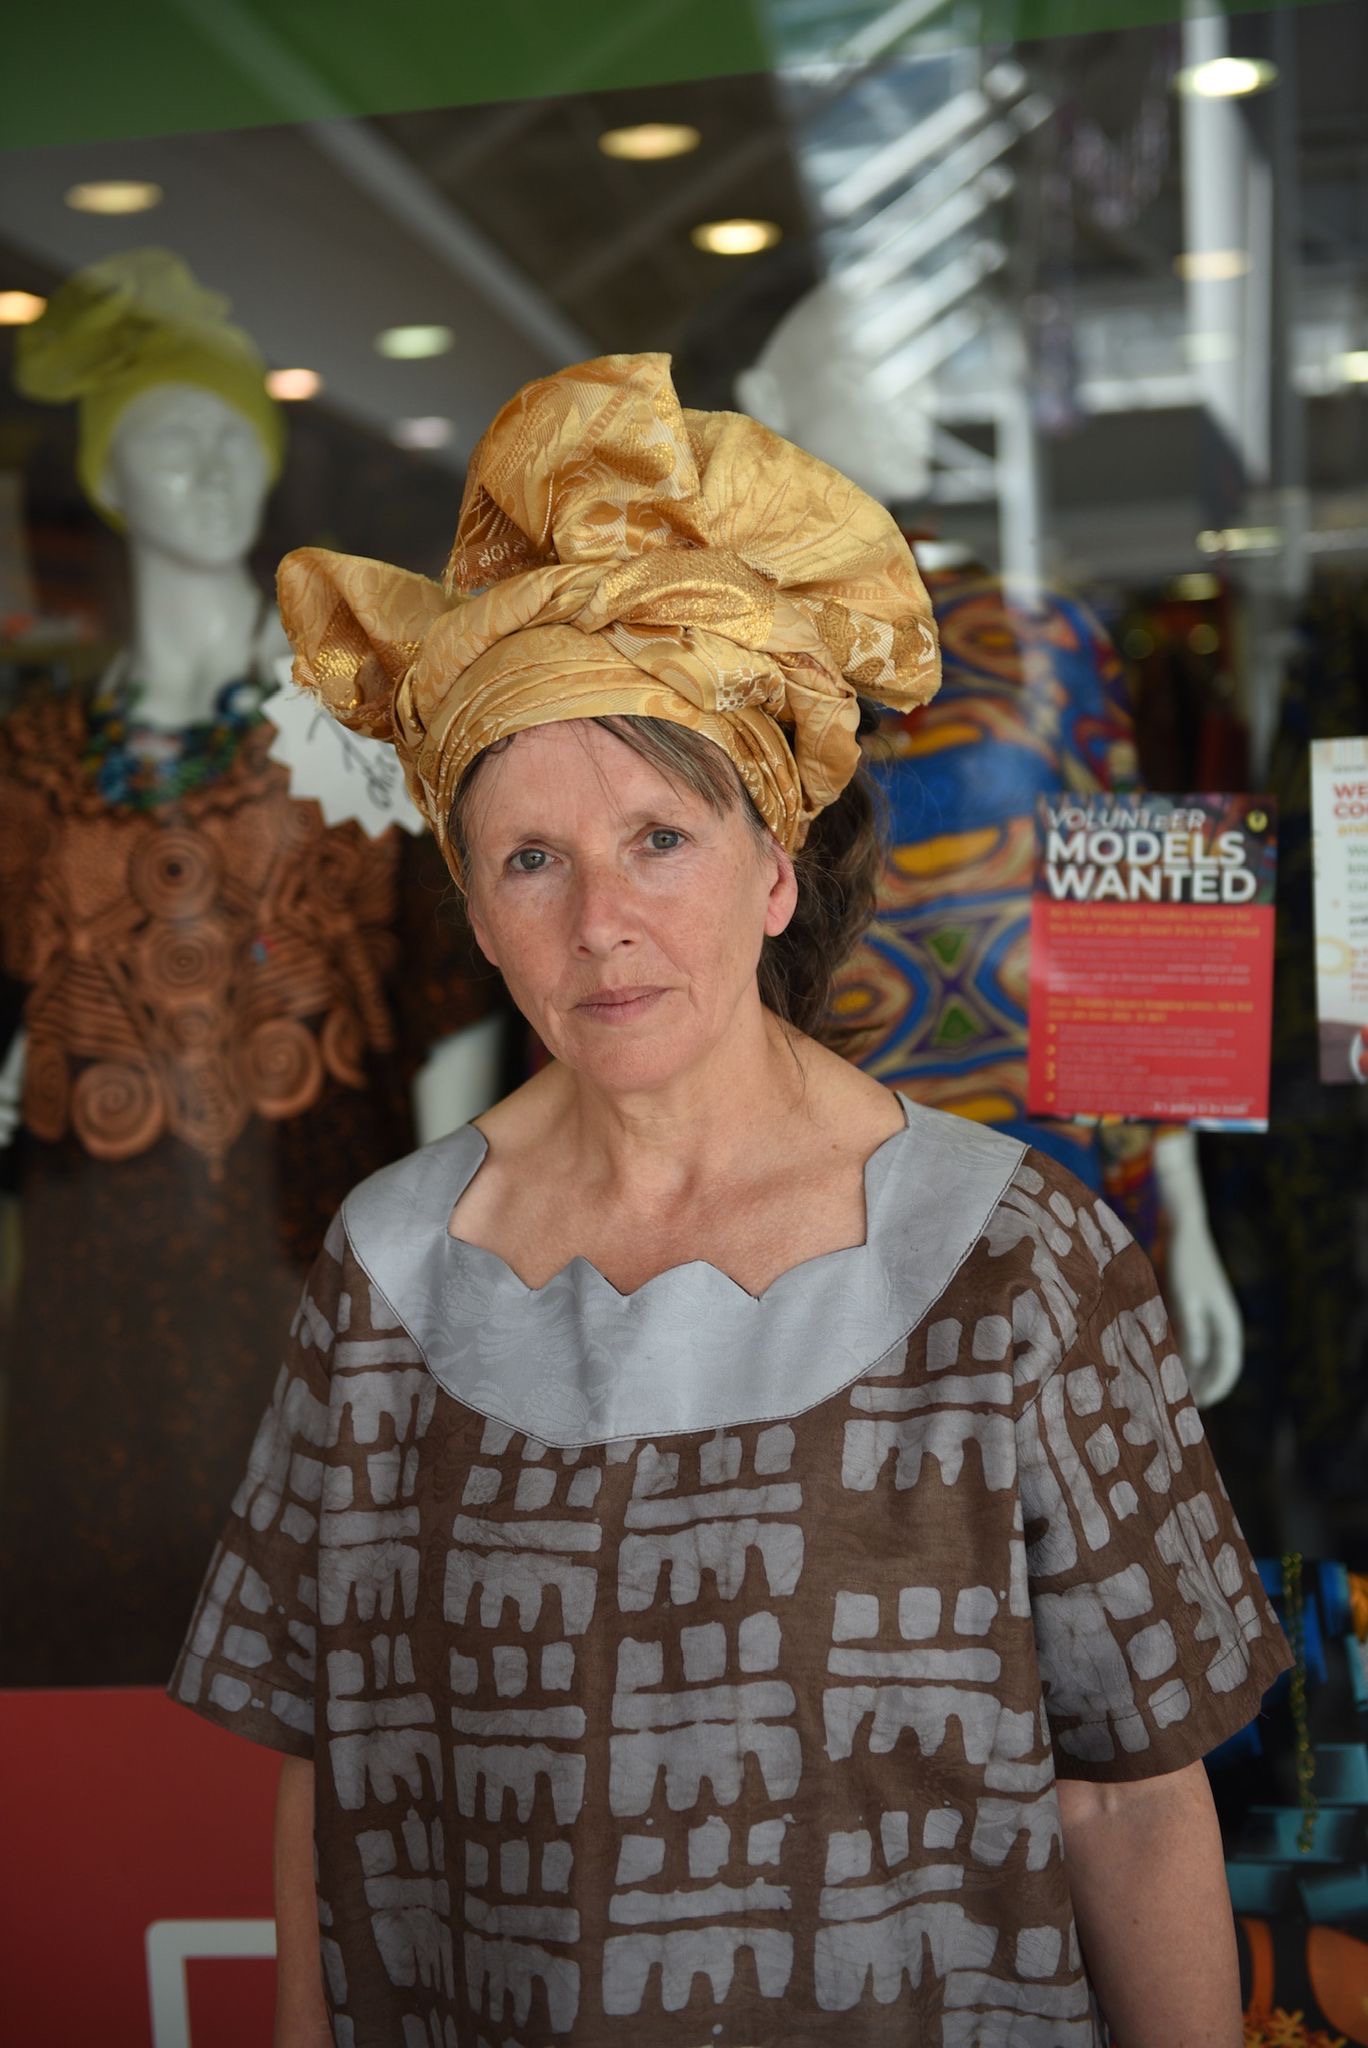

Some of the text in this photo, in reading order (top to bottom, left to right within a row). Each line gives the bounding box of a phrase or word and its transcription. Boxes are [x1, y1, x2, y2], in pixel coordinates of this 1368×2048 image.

[1047, 807, 1207, 831] VOLUNTEER
[1333, 801, 1368, 820] CO
[1047, 830, 1247, 866] MODELS
[1047, 863, 1257, 903] WANTED
